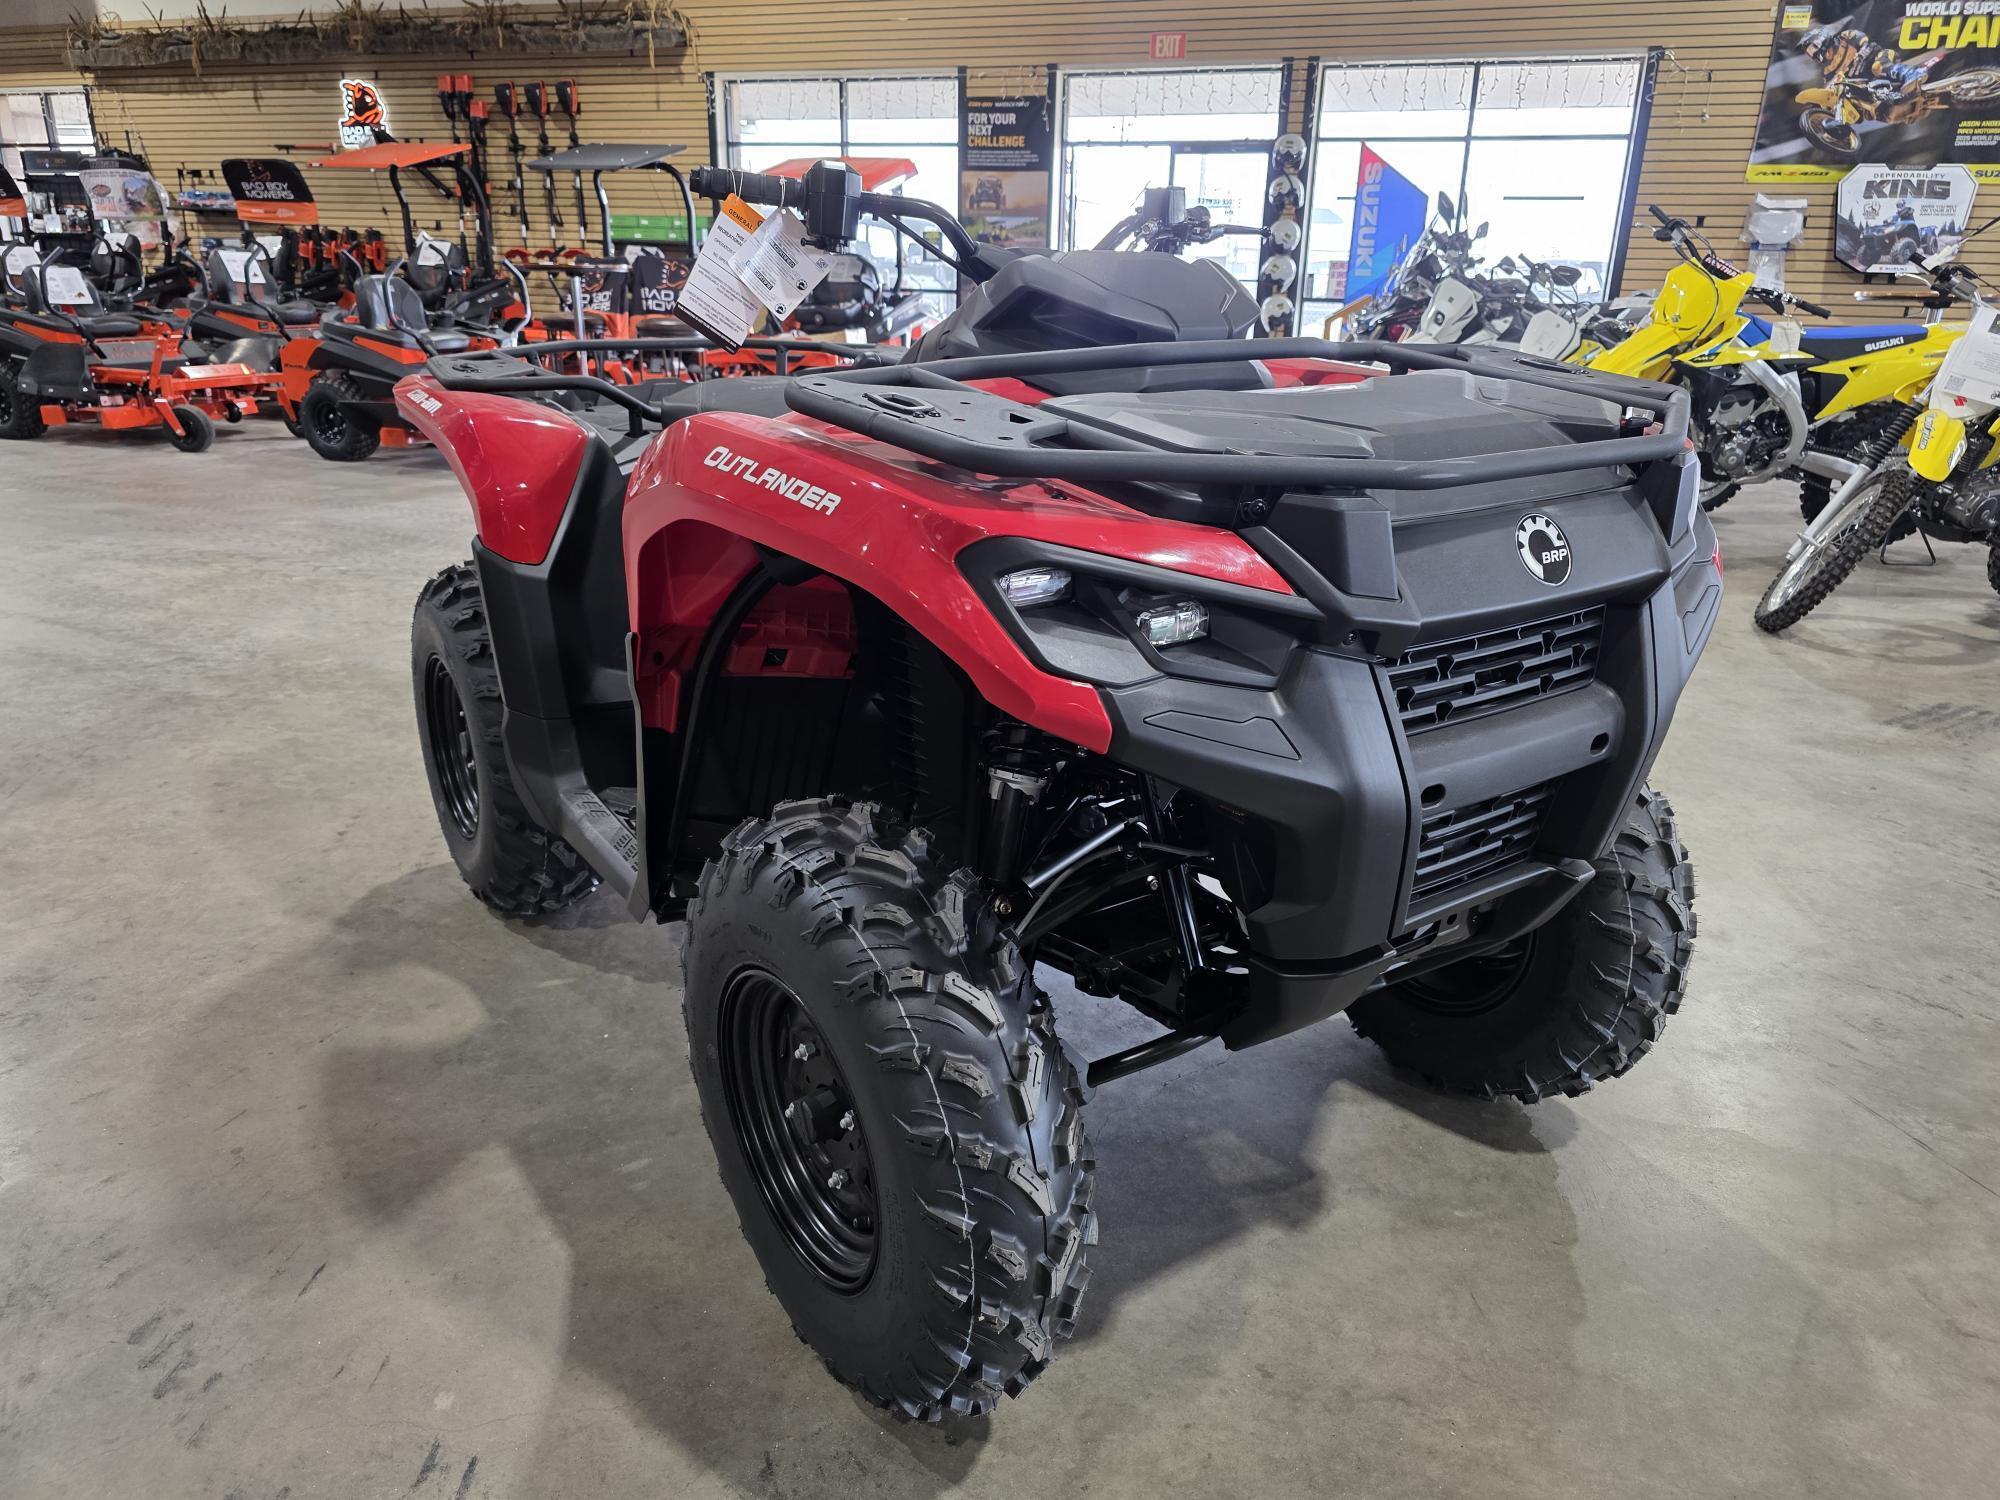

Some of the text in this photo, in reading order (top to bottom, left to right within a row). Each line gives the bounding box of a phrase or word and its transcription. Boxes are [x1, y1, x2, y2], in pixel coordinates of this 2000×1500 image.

[1905, 2, 1961, 16] WORLD
[1155, 35, 1182, 57] EXIT
[968, 112, 1017, 125] FOR YOUR
[342, 126, 363, 136] BAD
[968, 124, 993, 136] NEXT
[968, 136, 1025, 148] CHALLENGE
[241, 181, 289, 191] BAD BOY
[1862, 179, 1951, 200] KING
[244, 190, 295, 200] MOWERS
[728, 208, 753, 231] GENERAL
[1355, 162, 1383, 277] SUZUKI
[642, 299, 677, 312] MOW
[1864, 336, 1904, 352] SUZUKI
[703, 446, 842, 516] OUTLANDER
[1542, 548, 1568, 564] BRP
